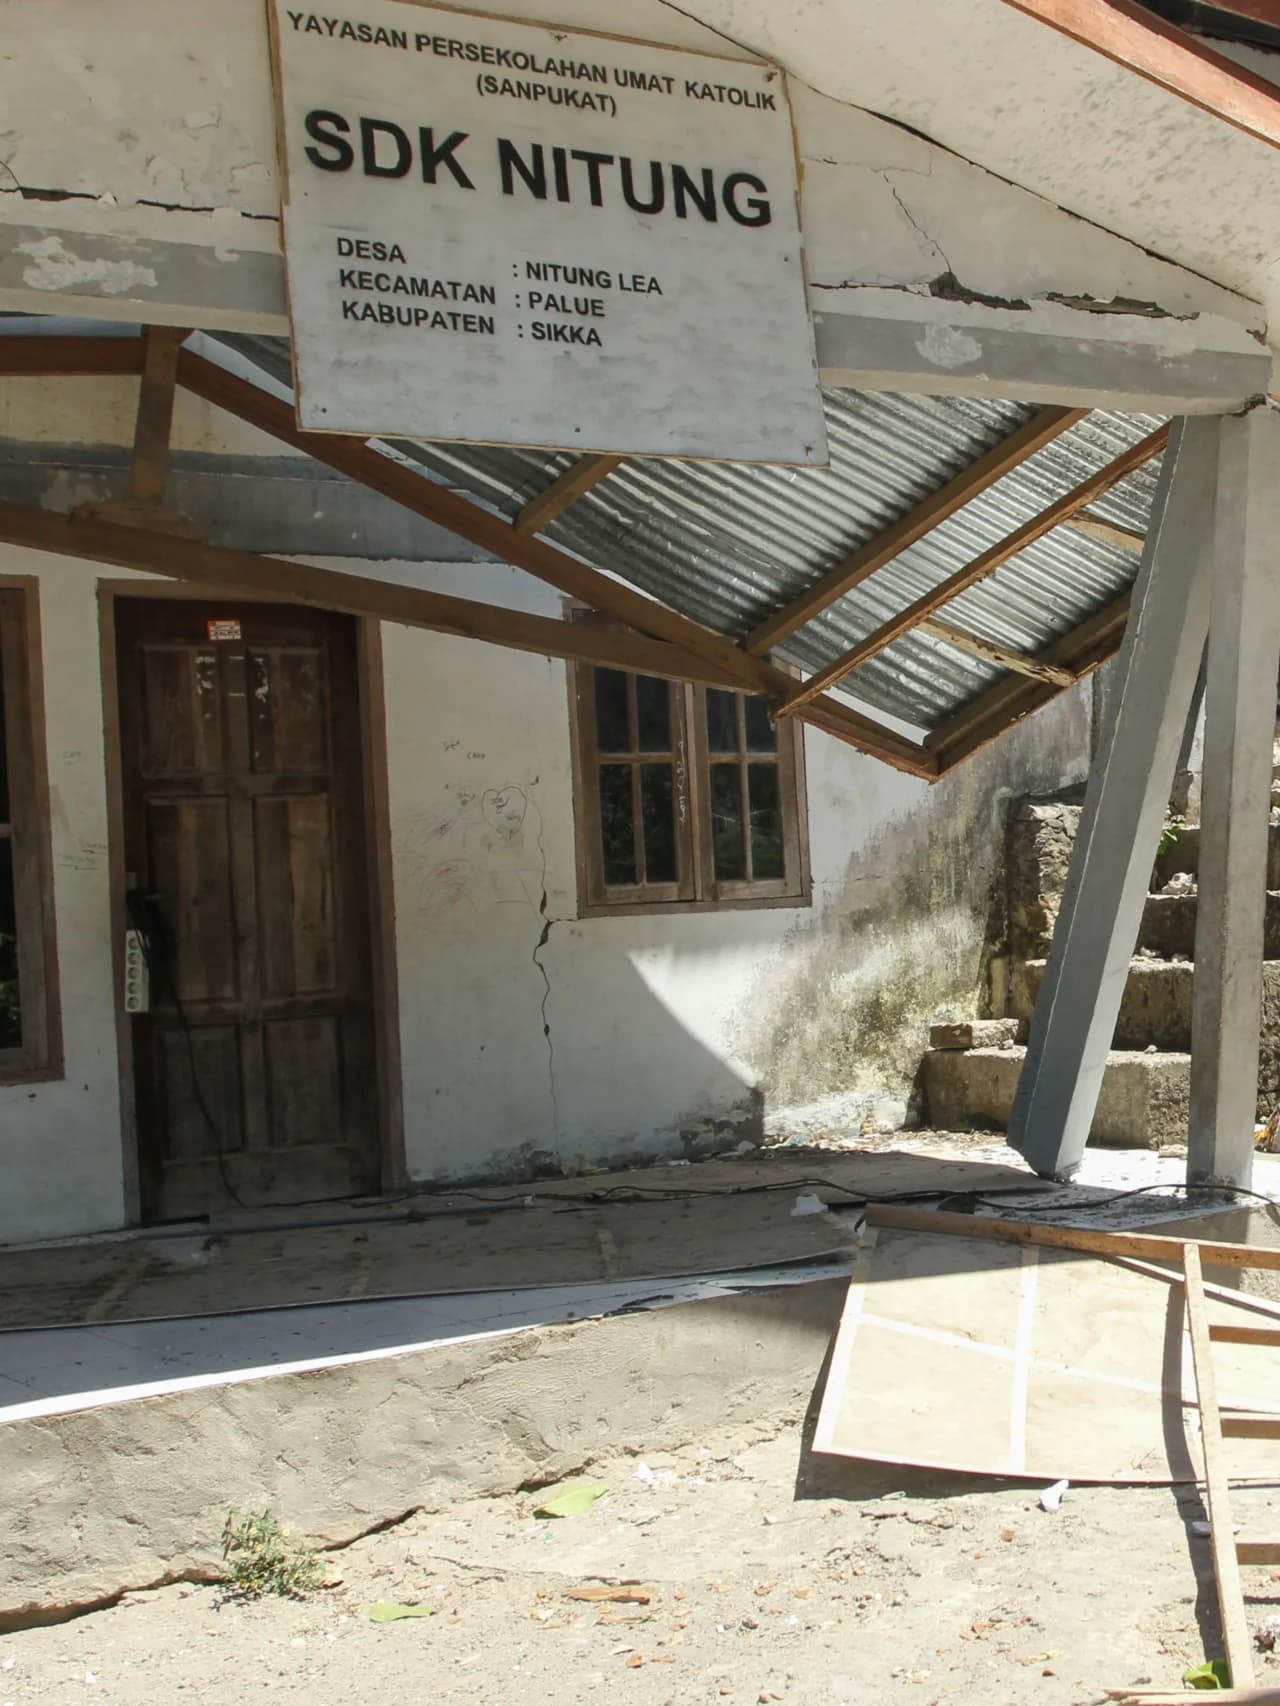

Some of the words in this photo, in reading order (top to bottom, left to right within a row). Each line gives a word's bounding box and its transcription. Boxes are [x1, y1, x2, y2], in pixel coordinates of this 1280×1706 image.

[287, 11, 408, 50] YAYASAN
[415, 34, 607, 84] PERSEKOLAHAN
[613, 68, 676, 95] UMAT
[684, 79, 777, 112] KATOLIK
[476, 73, 617, 118] (SANPUKAT)
[303, 109, 476, 191] SDK
[496, 137, 773, 229] NITUNG
[336, 237, 407, 265] DESA
[526, 261, 612, 289] NITUNG
[618, 272, 663, 296] LEA
[339, 268, 496, 305] KECAMATAN
[528, 291, 606, 318] PALUE
[341, 299, 495, 336] KABUPATEN
[532, 322, 603, 347] SIKKA
